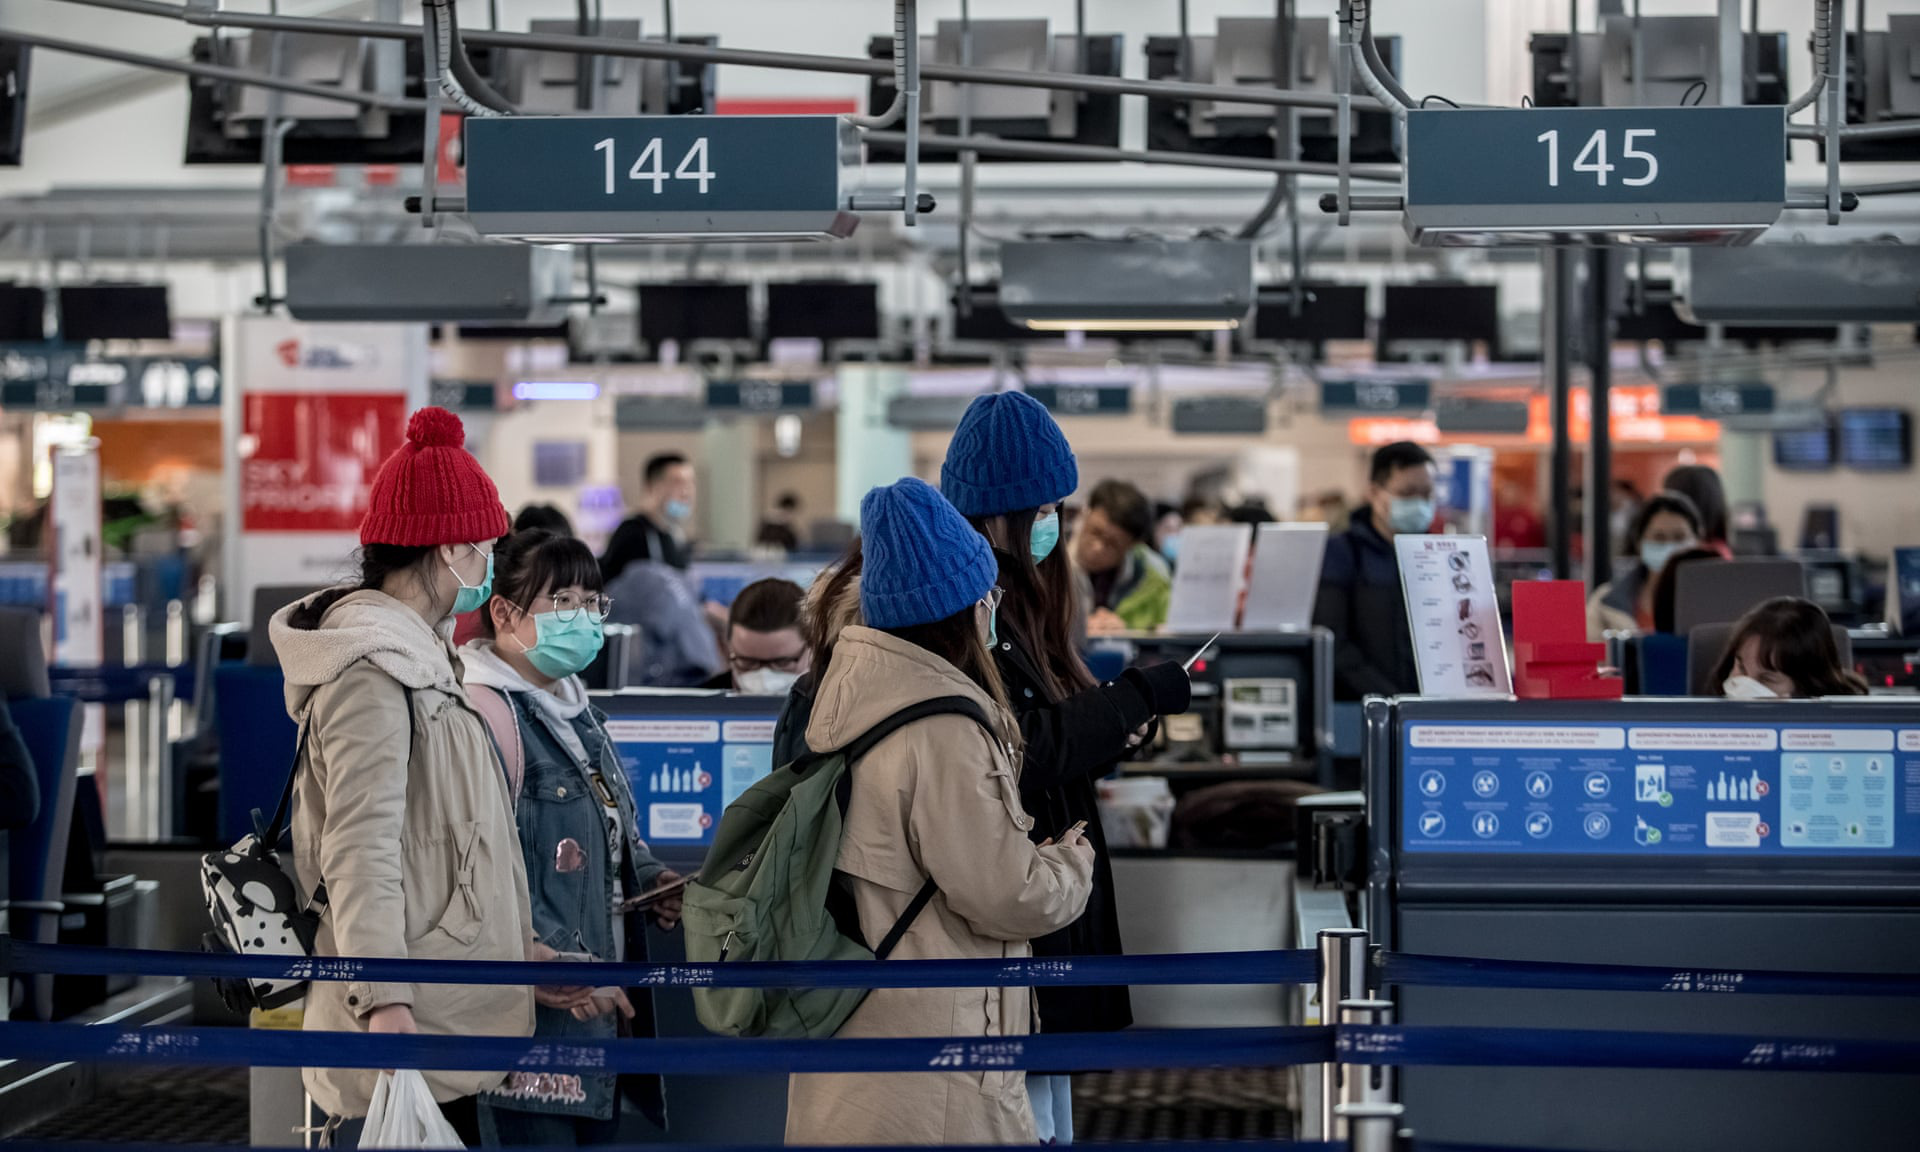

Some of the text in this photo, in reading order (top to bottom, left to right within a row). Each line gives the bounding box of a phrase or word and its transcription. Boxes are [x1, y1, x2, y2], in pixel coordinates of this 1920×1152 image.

[594, 137, 716, 194] 144
[1537, 129, 1658, 187] 145
[671, 967, 714, 978] Prague
[671, 976, 714, 984] Airport
